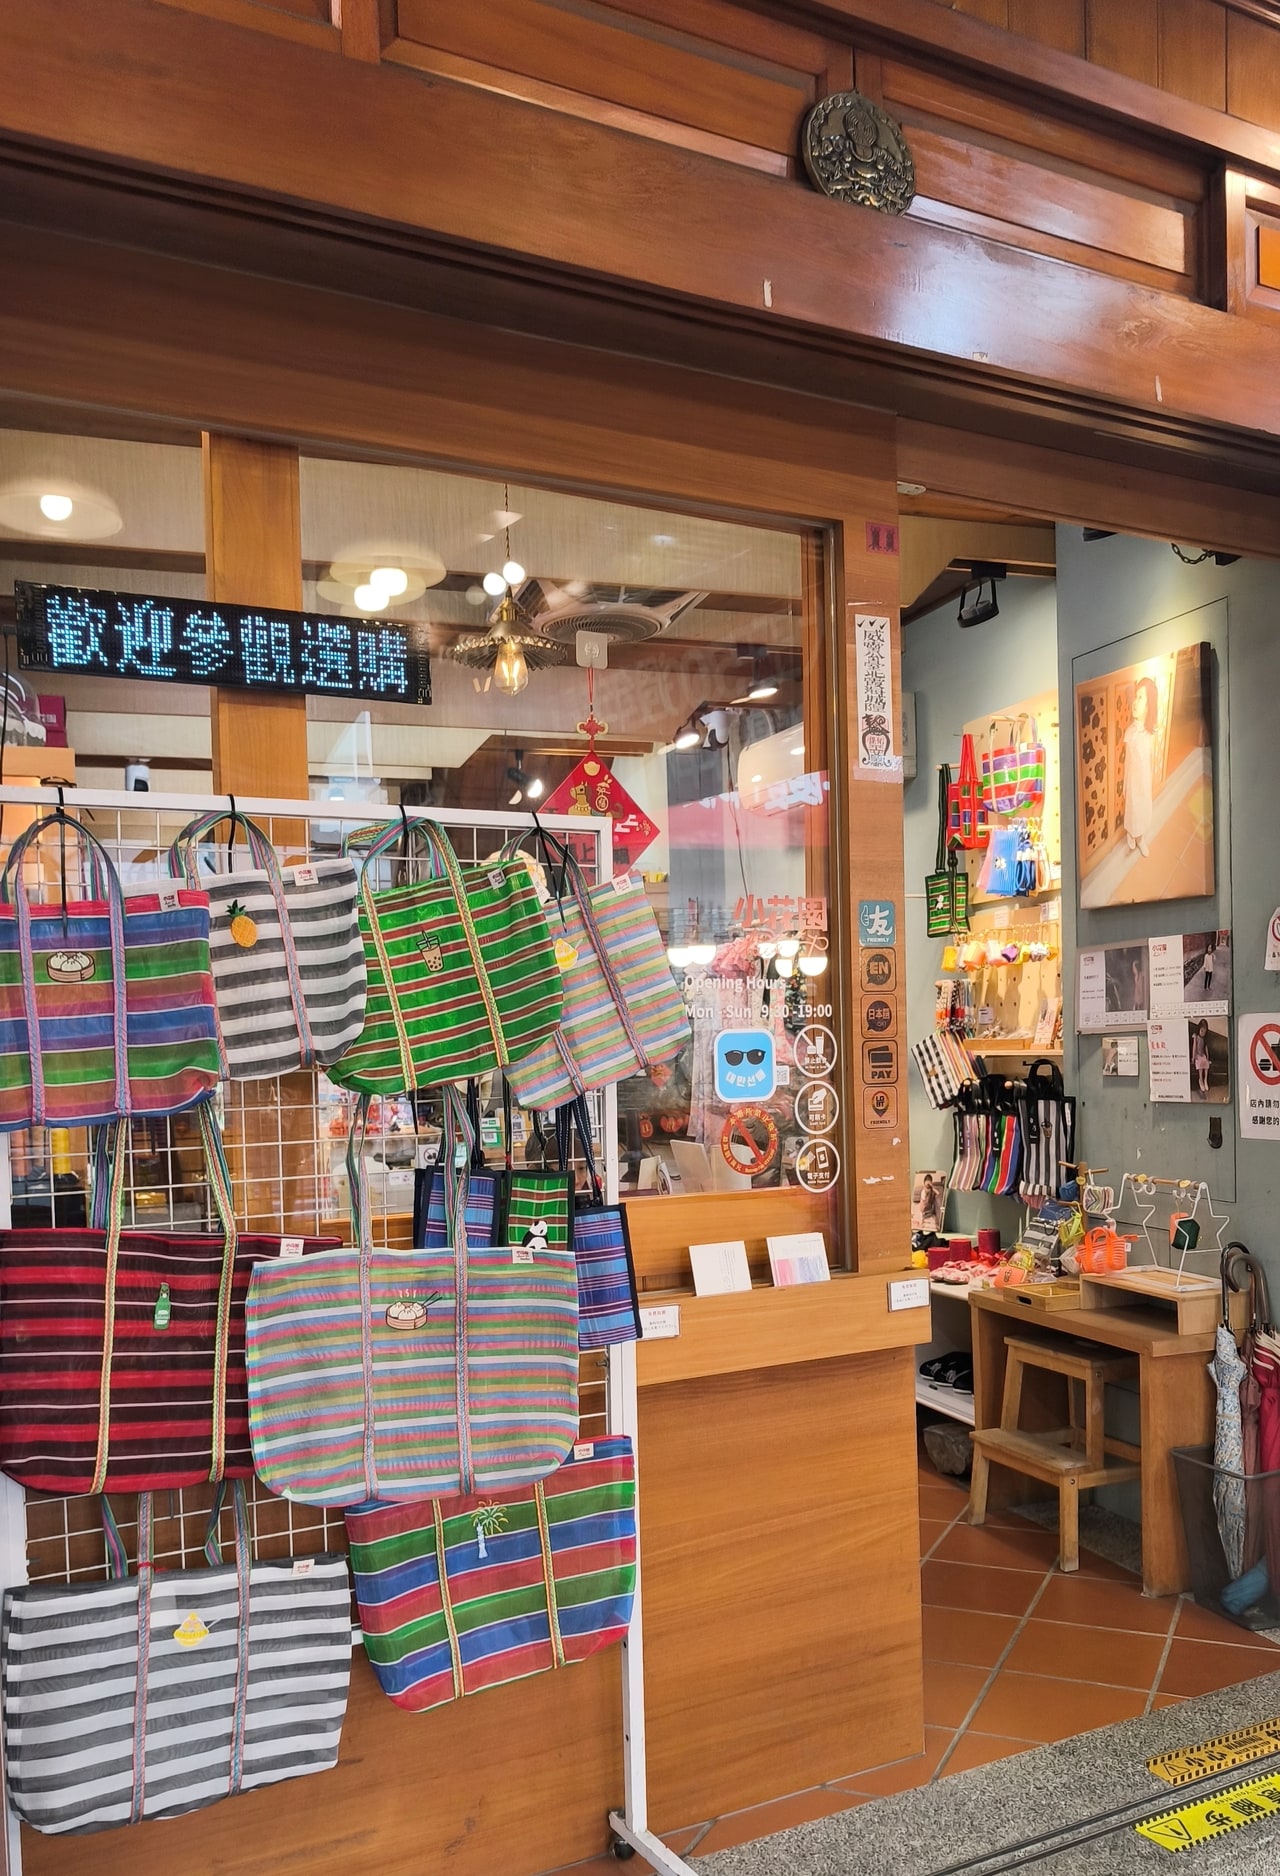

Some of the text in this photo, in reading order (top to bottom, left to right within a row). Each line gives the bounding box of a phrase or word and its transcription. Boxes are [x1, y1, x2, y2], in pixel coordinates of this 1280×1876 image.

[46, 595, 409, 693] 歡迎參觀選購
[733, 894, 828, 931] 小花園
[867, 905, 893, 936] 友
[870, 961, 888, 975] EN
[684, 975, 786, 992] Opening Hours
[685, 1005, 713, 1018] Mon
[726, 1004, 752, 1018] Sun
[871, 1070, 892, 1079] PAY
[1252, 1116, 1280, 1126] 感謝您的
[807, 1171, 830, 1180] 電子支付
